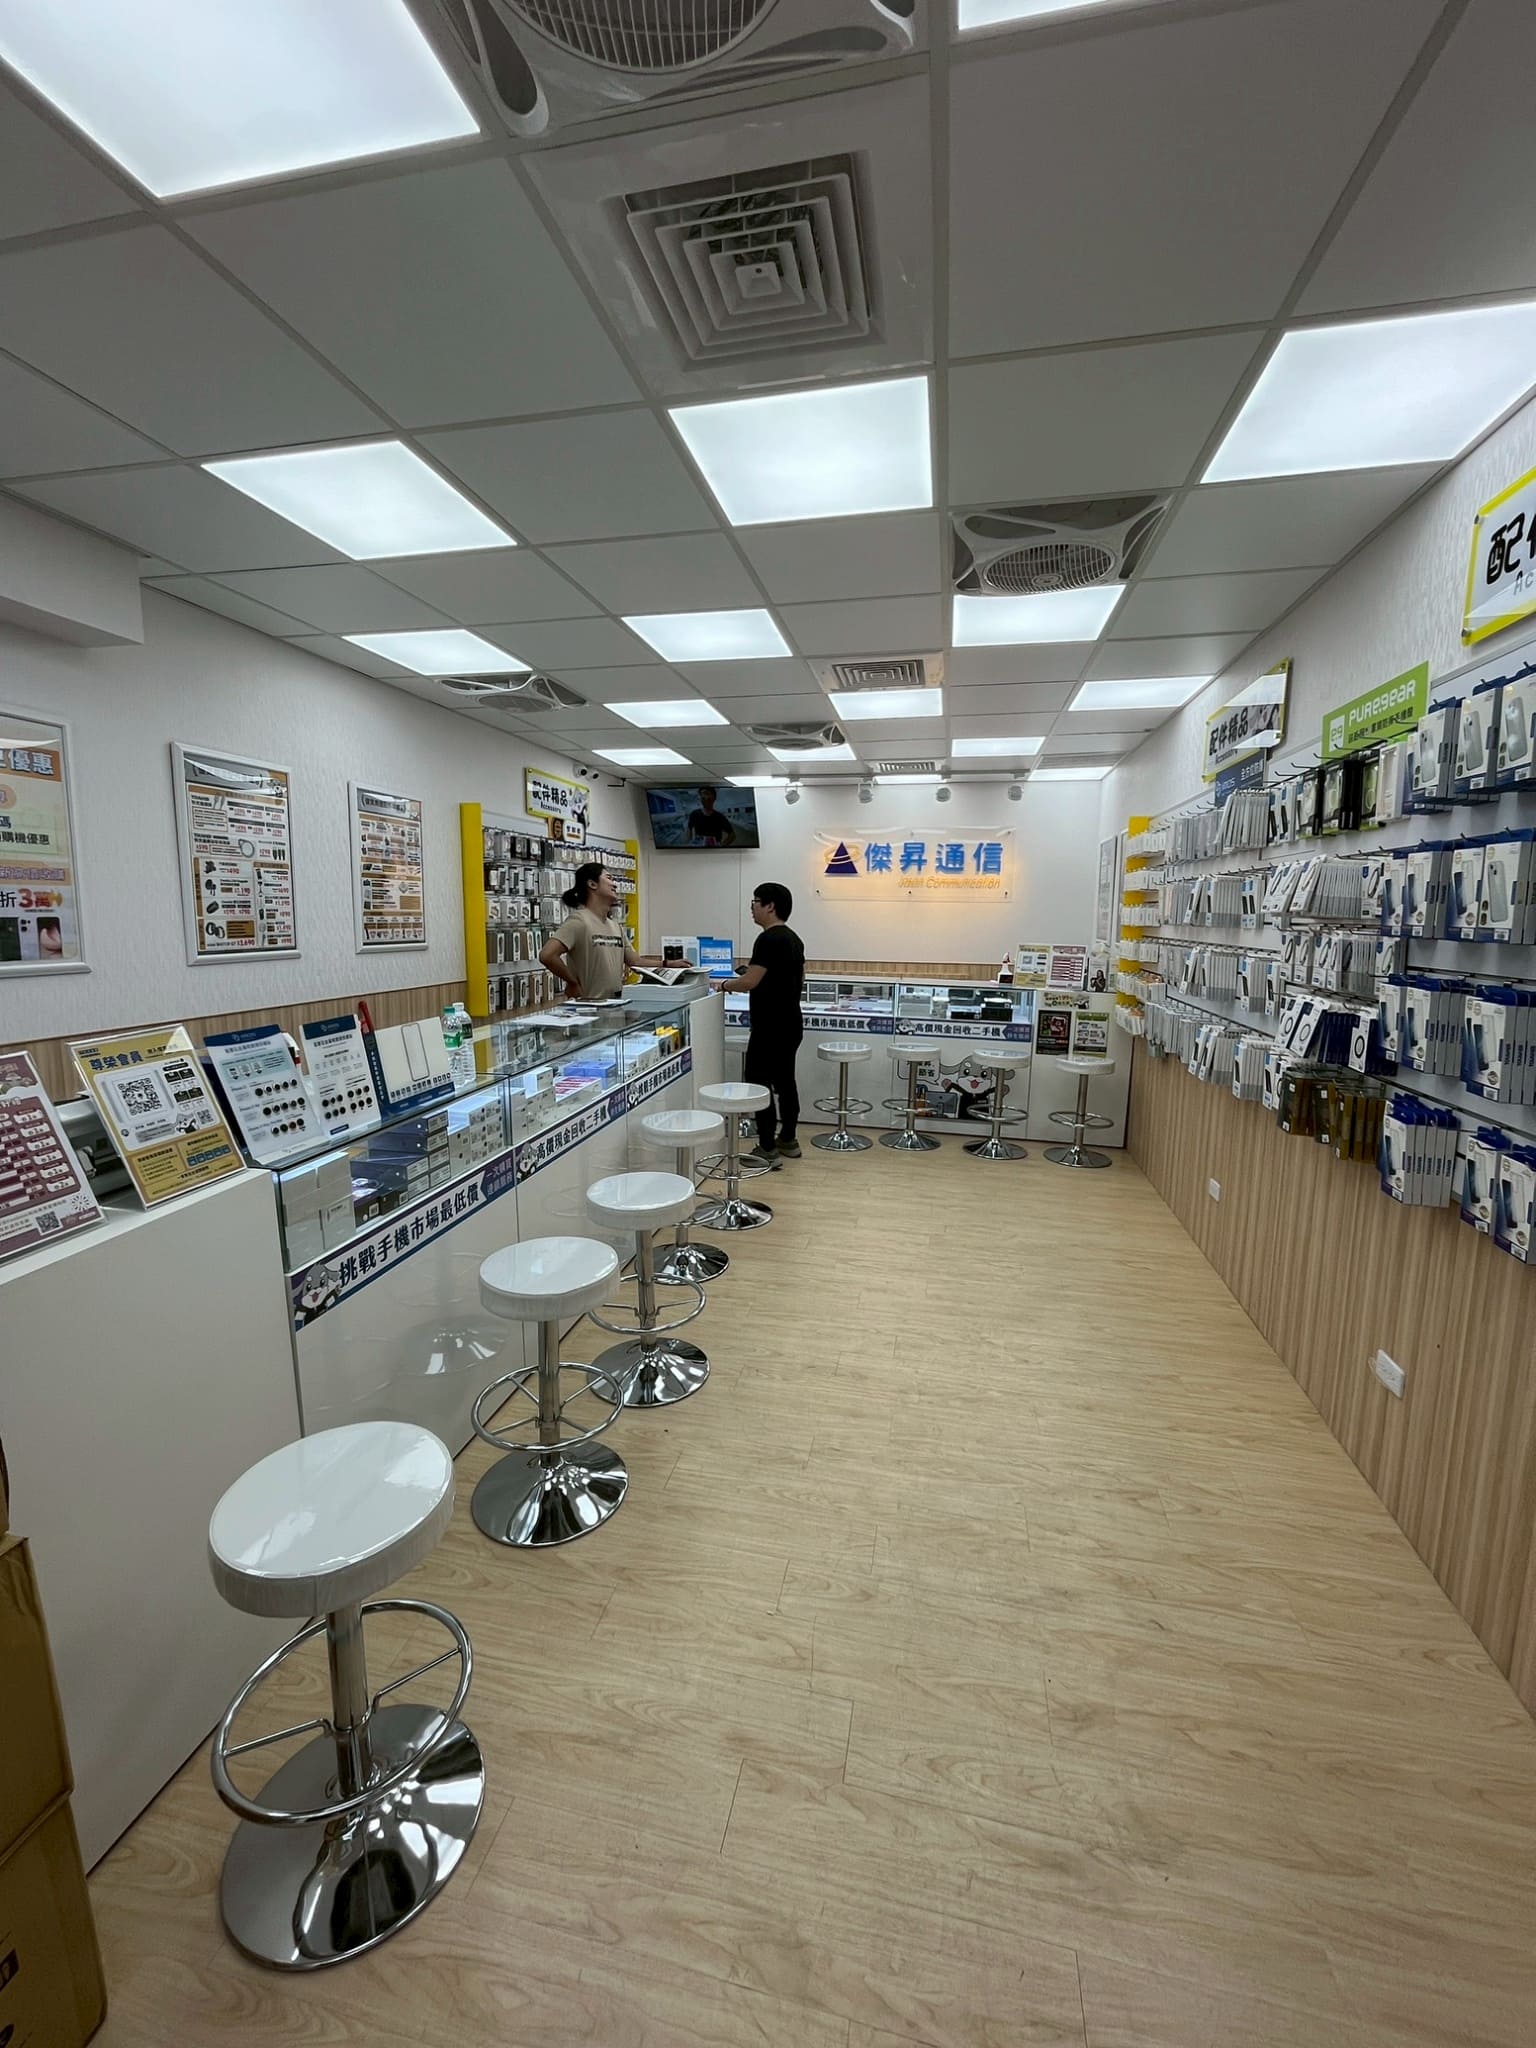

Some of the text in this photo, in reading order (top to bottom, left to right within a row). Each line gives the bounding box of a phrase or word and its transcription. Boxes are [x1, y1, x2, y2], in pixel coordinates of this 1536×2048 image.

[1209, 706, 1249, 756] 配件精品
[0, 749, 54, 776] 優惠
[533, 780, 568, 808] 配件精品
[864, 842, 1003, 875] 傑昇通信
[915, 1019, 1001, 1037] 高價現金回收二手機
[536, 1105, 607, 1162] 高價現金回收二手機
[339, 1181, 479, 1288] 挑戰手機市場最低價
